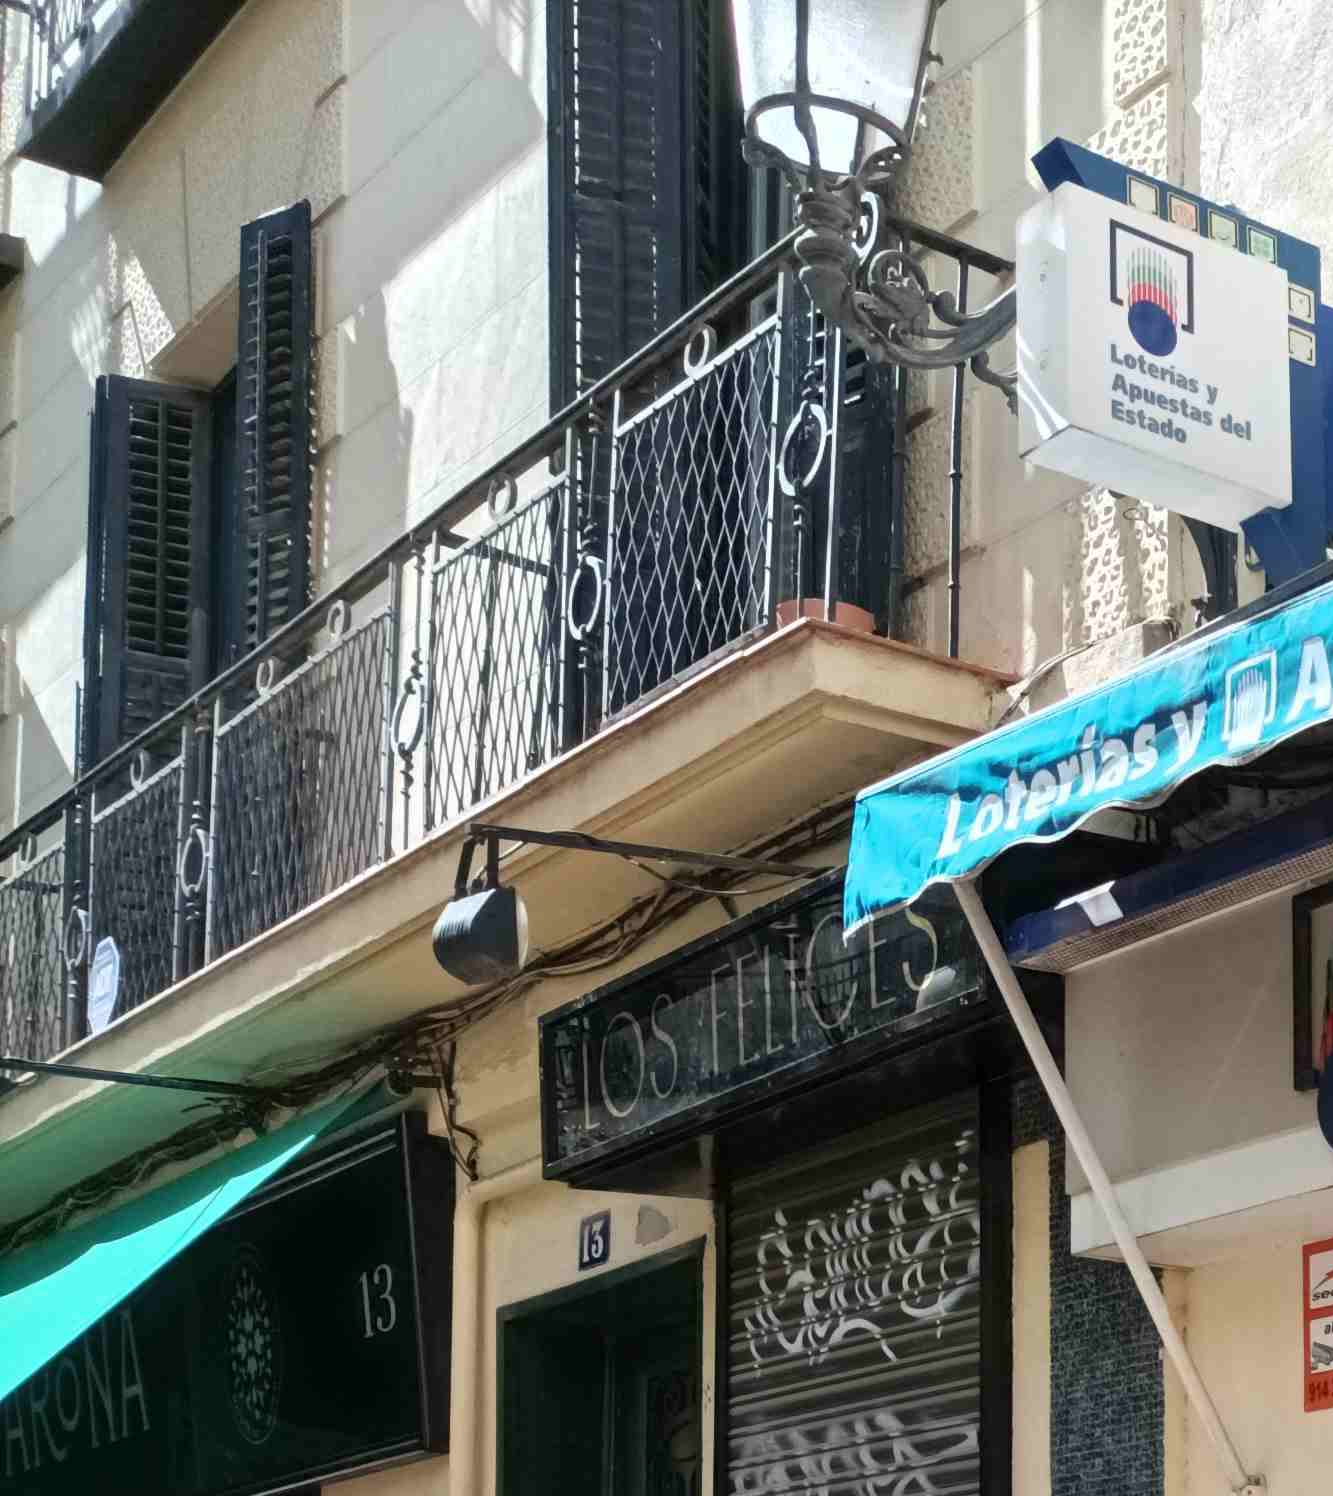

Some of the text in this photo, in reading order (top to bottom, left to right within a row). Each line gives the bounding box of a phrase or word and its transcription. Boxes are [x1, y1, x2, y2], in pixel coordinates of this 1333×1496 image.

[1111, 399, 1187, 443] Estado
[1112, 373, 1252, 441] Apuestas del
[1206, 384, 1218, 405] y
[936, 722, 1159, 859] Loterías
[1170, 699, 1208, 772] y
[581, 907, 938, 1131] LOS FELICES
[358, 1263, 397, 1339] 13
[1308, 1380, 1329, 1402] 914
